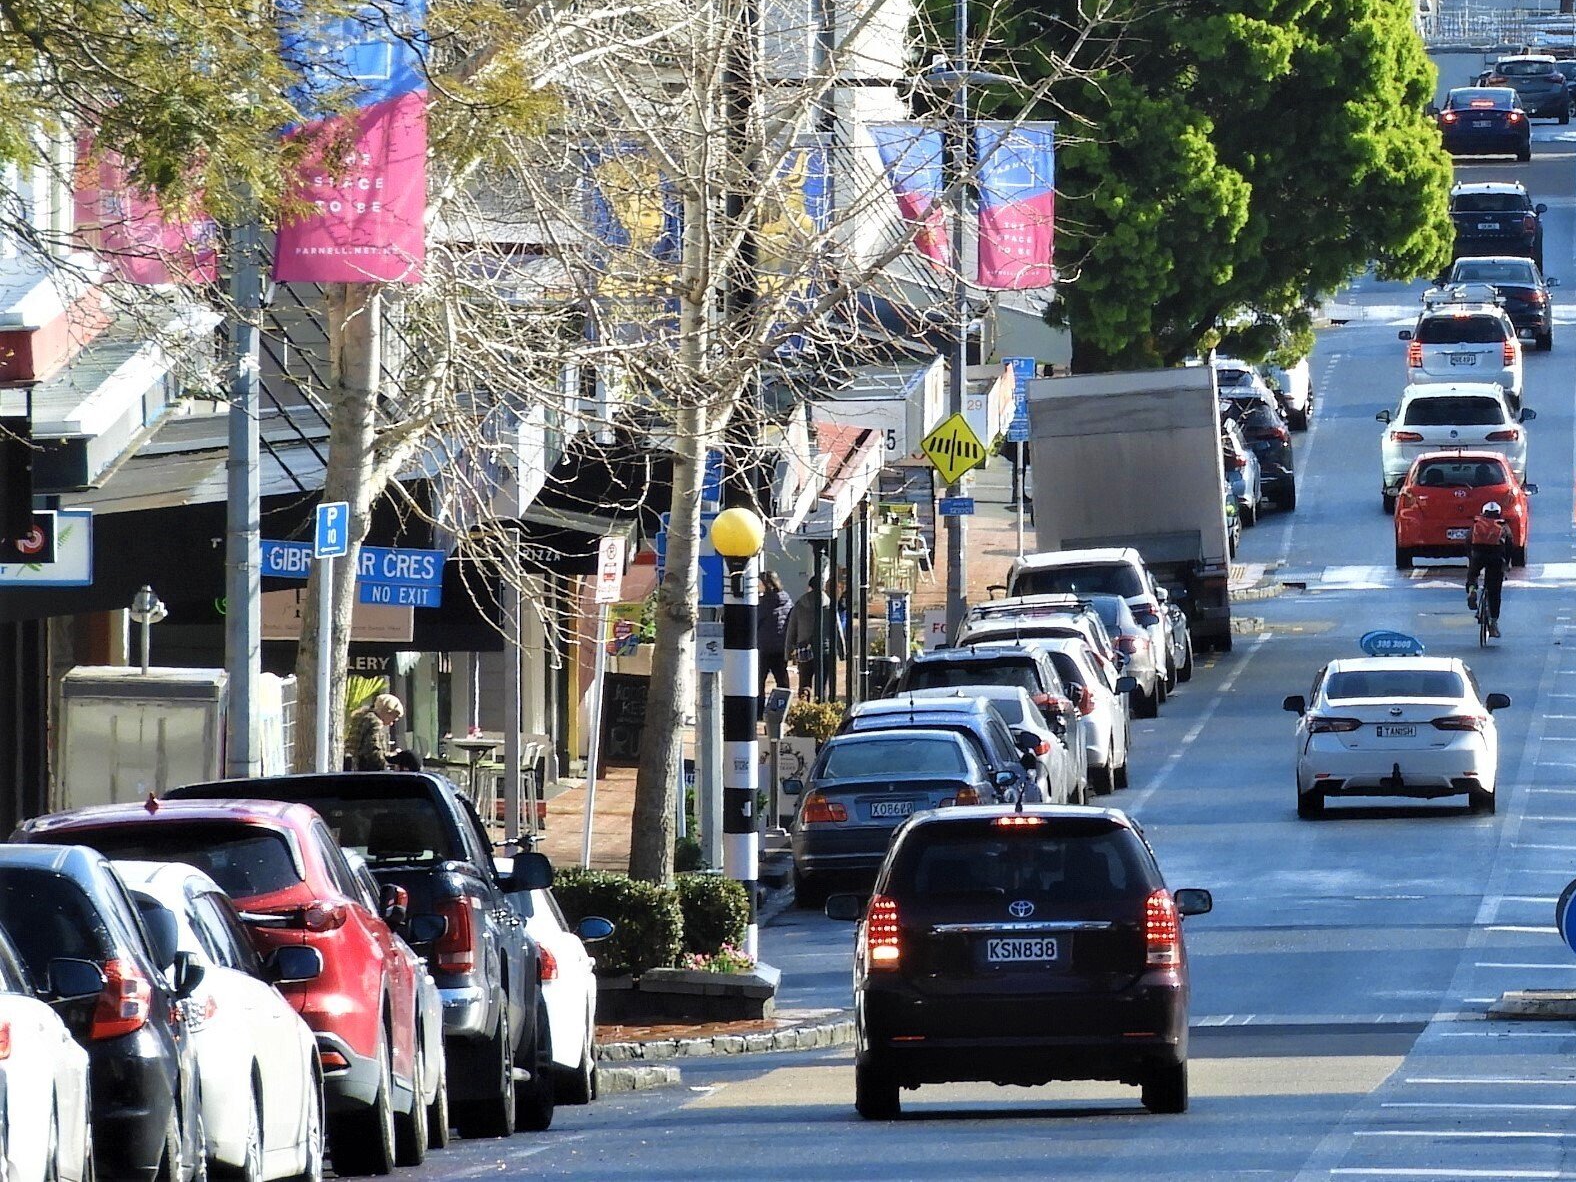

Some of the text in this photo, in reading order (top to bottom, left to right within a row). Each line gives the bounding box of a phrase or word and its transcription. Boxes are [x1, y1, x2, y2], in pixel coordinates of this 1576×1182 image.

[314, 200, 382, 213] TO BE
[295, 247, 399, 255] PARNELL.NET.N
[967, 399, 983, 411] 29
[327, 529, 337, 544] 10
[383, 552, 434, 579] CRES
[372, 586, 429, 605] NO EXIT
[989, 941, 1055, 959] KSN838
